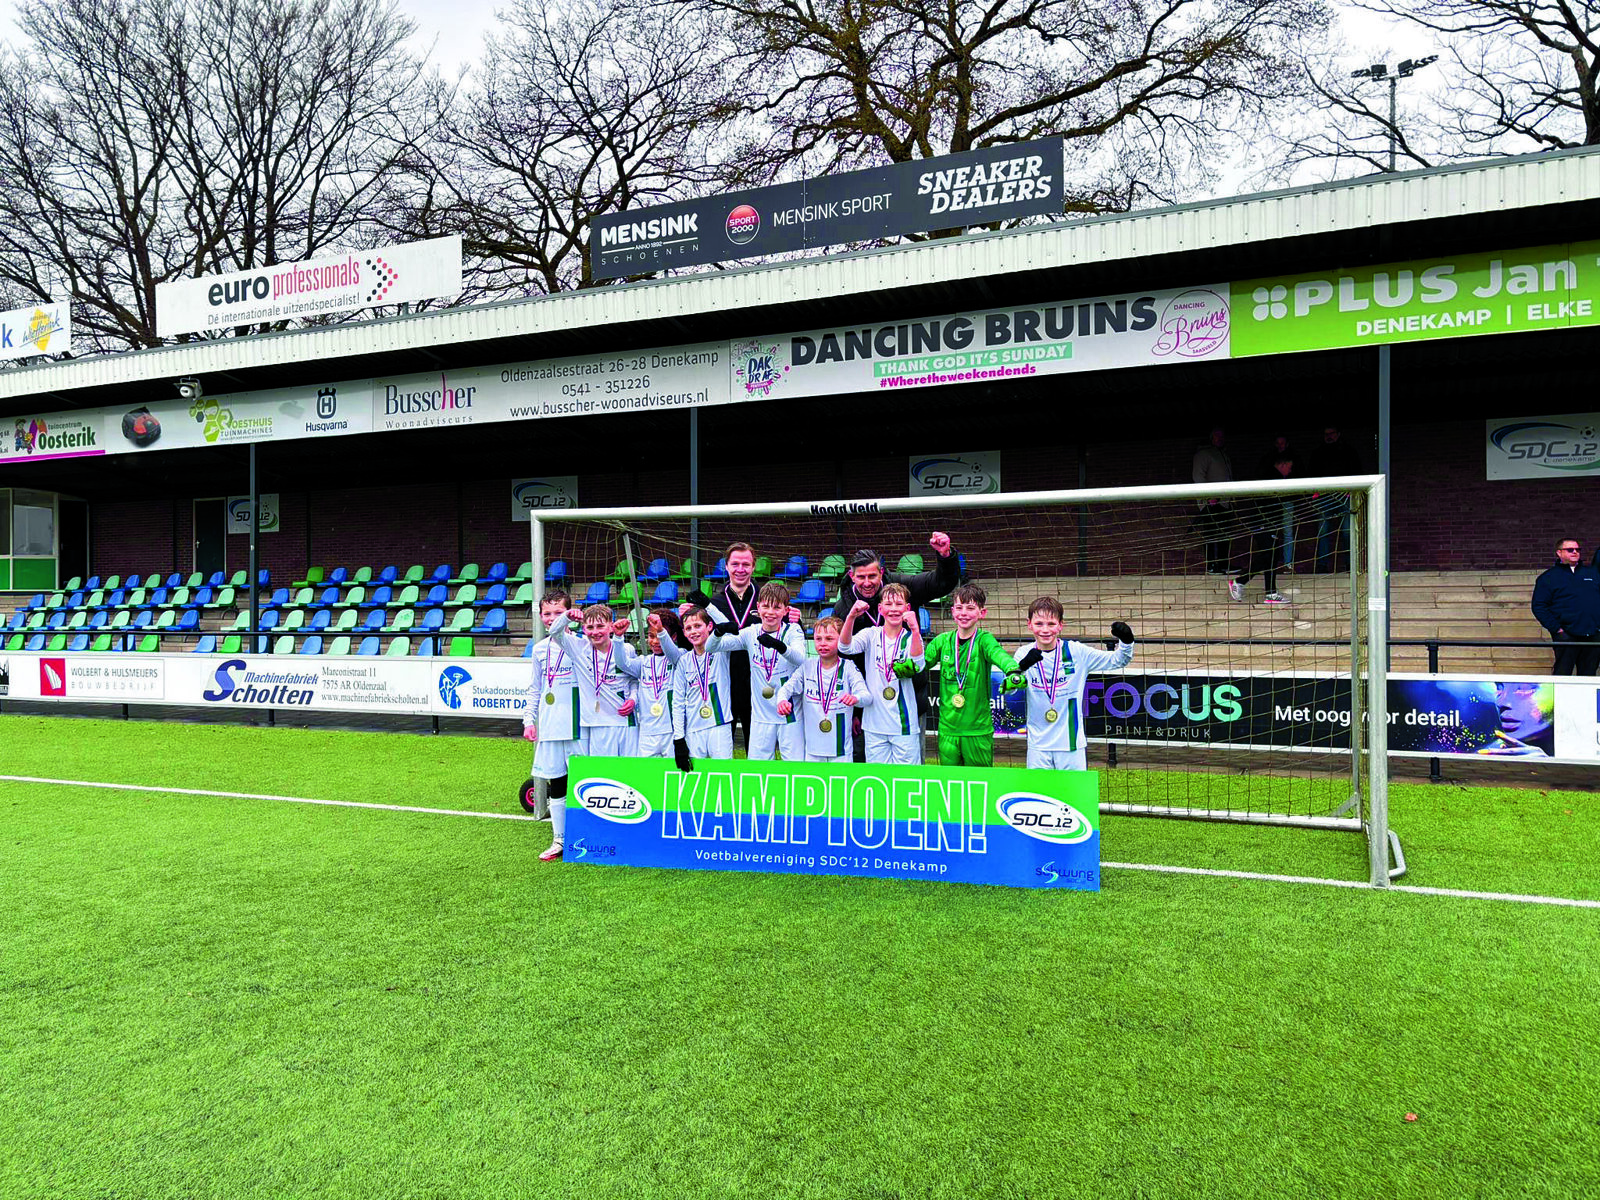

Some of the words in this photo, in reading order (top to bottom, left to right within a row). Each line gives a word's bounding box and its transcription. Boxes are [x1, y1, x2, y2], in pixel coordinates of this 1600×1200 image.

[918, 155, 1043, 195] SNEAKER
[930, 175, 1052, 215] DEALERS
[729, 215, 756, 226] SPORT
[773, 201, 839, 228] MENSINK
[841, 193, 893, 216] SPORT
[600, 212, 699, 247] MENSINK
[731, 224, 754, 234] 2000
[601, 244, 699, 266] SCHOENEN
[634, 243, 650, 251] ANNO
[208, 275, 270, 306] euro
[273, 255, 360, 300] professionals
[1294, 264, 1458, 317] PLUS
[1472, 259, 1577, 299] Jan
[207, 314, 219, 326] Dé
[221, 304, 280, 324] internationale
[283, 292, 360, 316] uitzendspecialist!
[1173, 301, 1206, 311] DANCING
[1356, 308, 1492, 336] DENEKAMP
[1527, 299, 1593, 321] ELKE
[792, 317, 975, 366] DANCING
[985, 296, 1158, 347] BRUINS
[1151, 307, 1228, 357] Bruins
[501, 362, 605, 383] Oldenzaalsestraat
[608, 357, 647, 373] 26-28
[651, 351, 719, 369] Denekamp
[748, 355, 773, 375] DAK
[879, 358, 929, 375] THANK
[932, 354, 968, 370] GOD
[971, 351, 998, 366] IT'S
[1001, 345, 1067, 363] SUNDAY
[561, 382, 591, 397] 0541
[605, 374, 651, 394] 351226
[880, 363, 1037, 388] #Wheretheweekendends
[384, 371, 477, 416] Busscher
[510, 387, 709, 417] www.busscher-woonadviseurs.nl
[220, 426, 273, 437] TUINMACHINES
[305, 419, 348, 432] Husqvarna
[385, 415, 473, 429] Woonadviseurs
[38, 426, 96, 450] Oosterik
[71, 667, 102, 677] WOLBERT
[103, 667, 110, 677] &
[203, 659, 314, 705] Scholten
[244, 671, 319, 685] Machinefabriek
[322, 666, 367, 677] Marconistraat
[322, 679, 339, 690] 7575
[340, 680, 352, 690] AR
[353, 680, 387, 691] Oldenzaal
[321, 692, 429, 705] www.machinefabriekscholten.nl
[472, 697, 512, 709] ROBERT
[1083, 681, 1243, 723] FOCUS
[1274, 704, 1311, 722] Met
[1315, 709, 1351, 727] oog
[1404, 708, 1460, 726] detail
[1105, 725, 1212, 740] PRINT&DRUK
[661, 771, 988, 855] KAMPIOEN!
[695, 849, 815, 868] Voetbalvereniging
[819, 855, 869, 869] SDC'12
[874, 858, 948, 875] Denekamp
